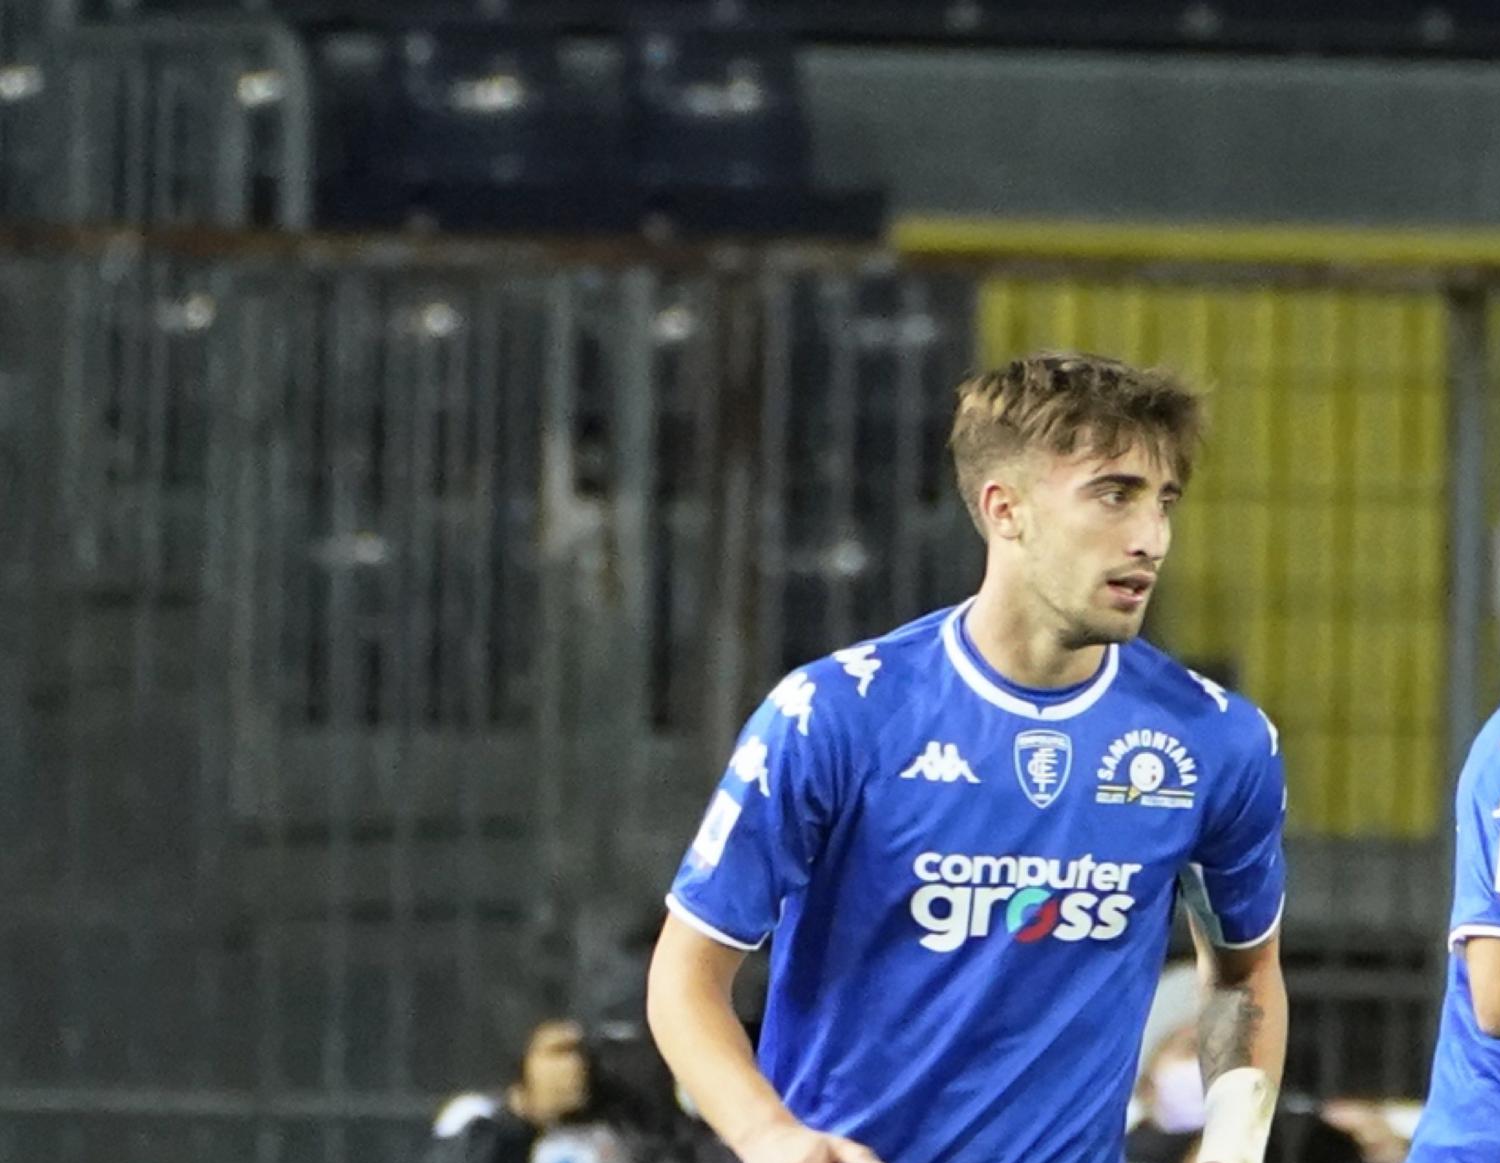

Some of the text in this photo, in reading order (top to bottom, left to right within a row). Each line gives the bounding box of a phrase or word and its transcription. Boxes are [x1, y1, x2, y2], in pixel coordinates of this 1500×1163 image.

[1096, 729, 1199, 786] SAMMONTANA
[913, 852, 1142, 891] computer
[910, 883, 1135, 952] gross
